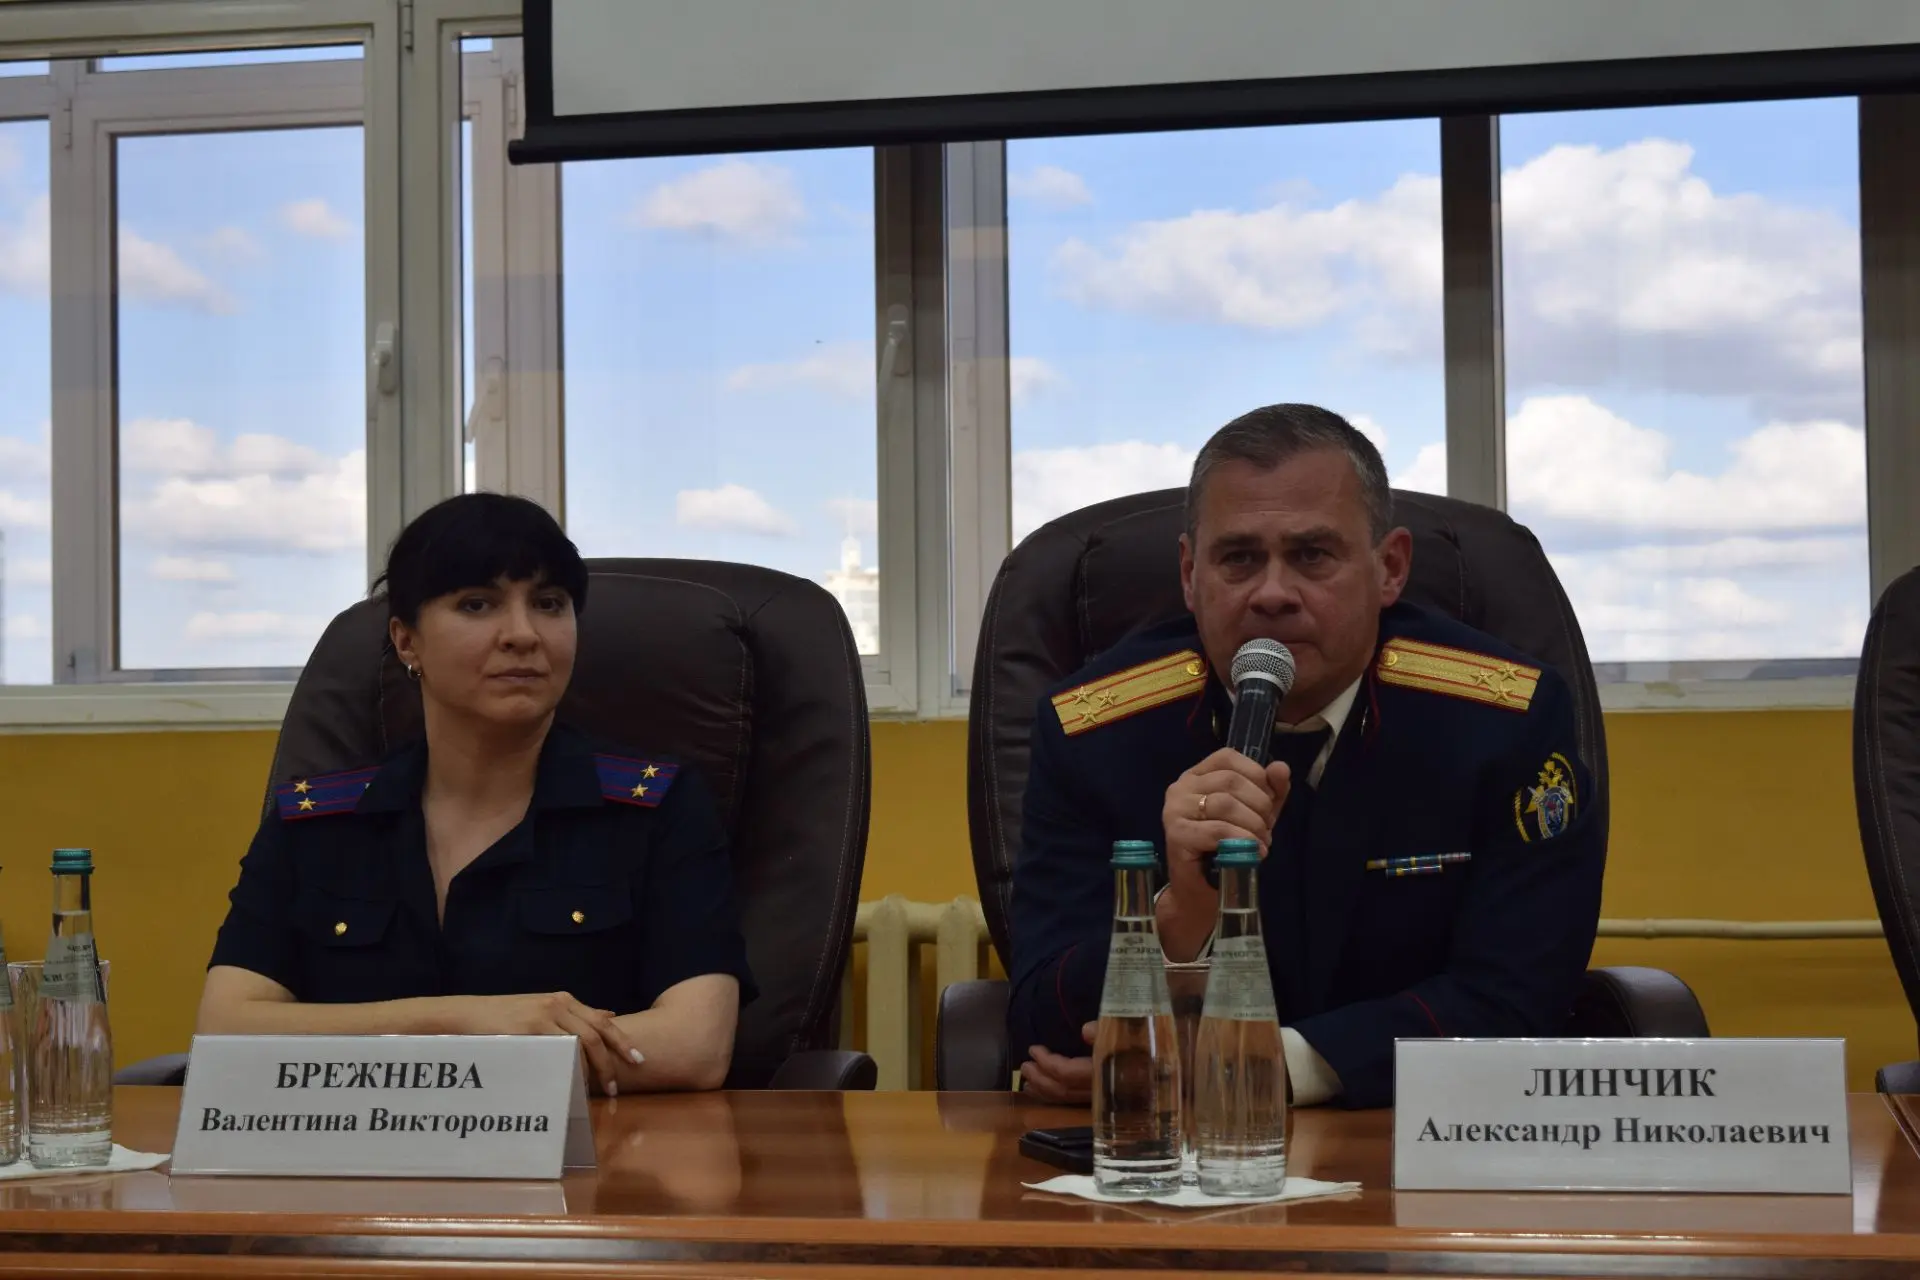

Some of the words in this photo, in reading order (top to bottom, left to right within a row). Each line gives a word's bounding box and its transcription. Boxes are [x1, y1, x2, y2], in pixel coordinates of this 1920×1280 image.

[275, 1062, 484, 1089] БРЕЖНЕВА
[1523, 1068, 1717, 1097] ЛИНЧИК
[199, 1107, 358, 1132] Валентина
[368, 1107, 549, 1139] Викторовна
[1417, 1117, 1601, 1150] Александр
[1613, 1117, 1830, 1144] Николаевич
